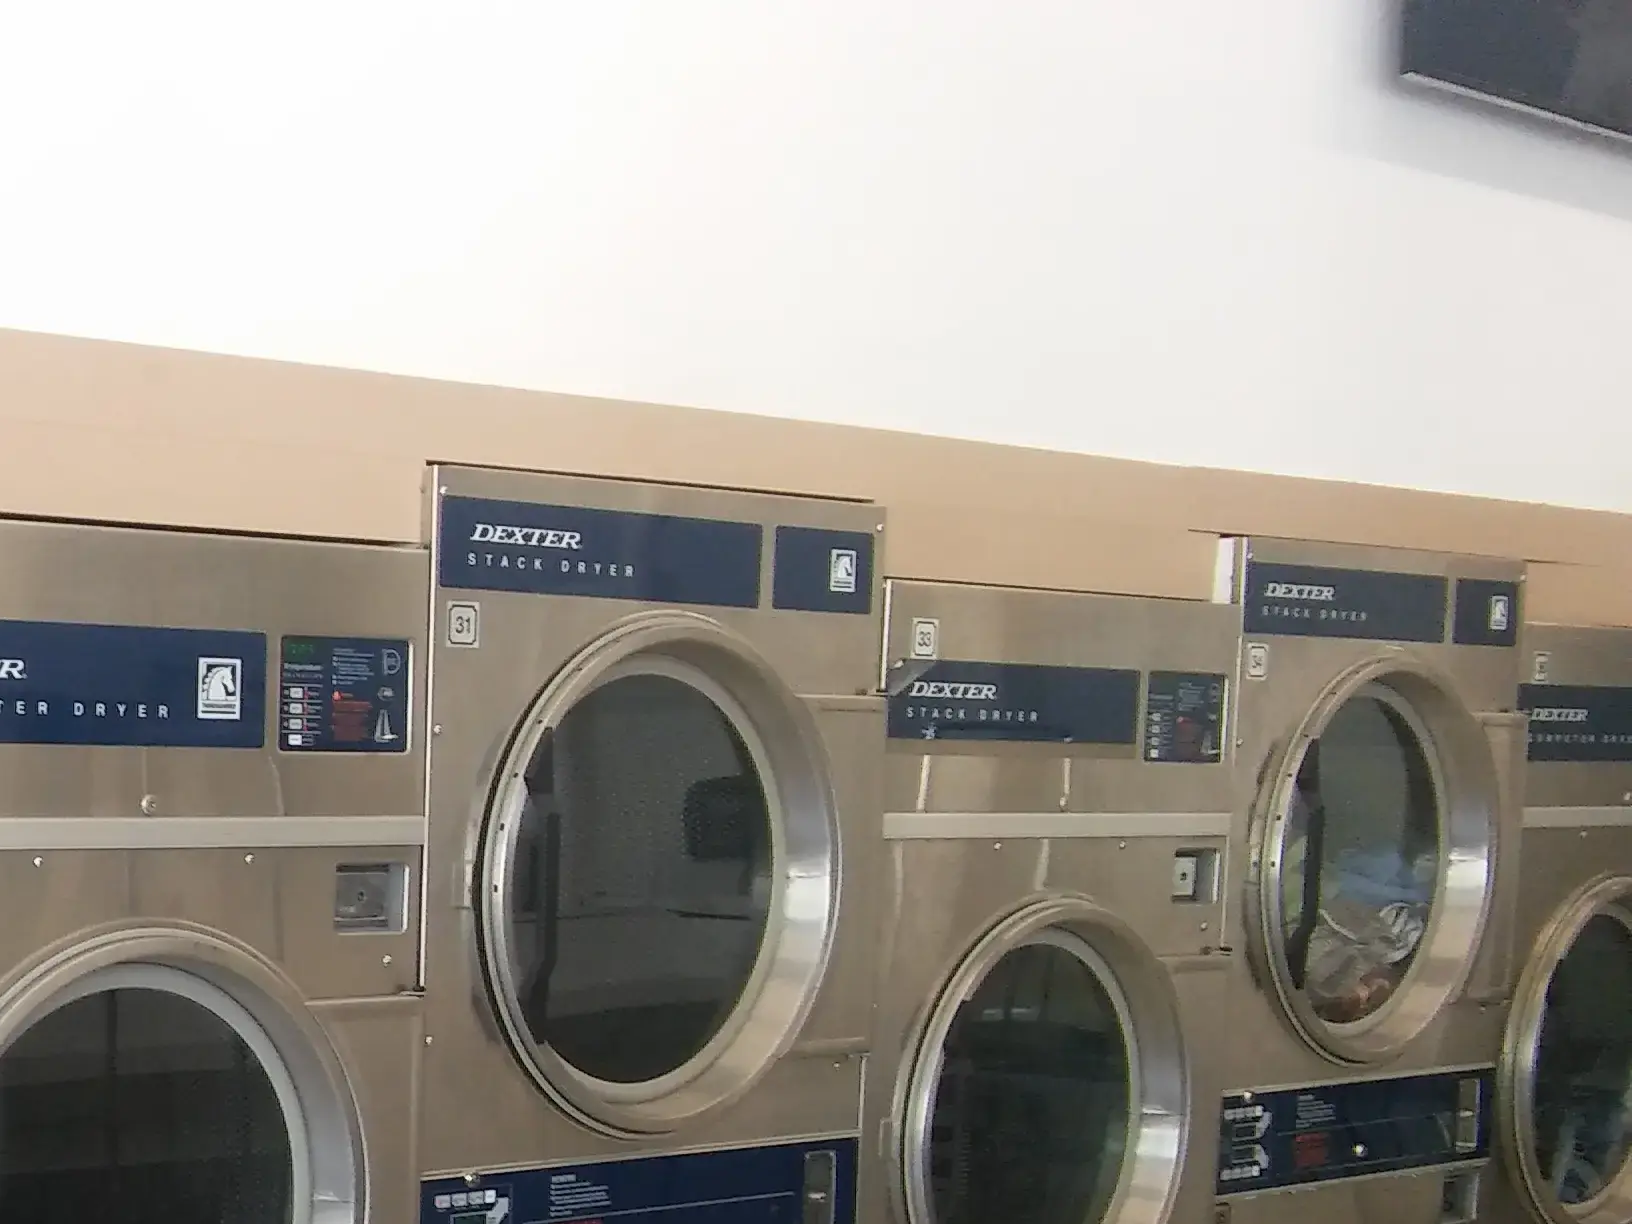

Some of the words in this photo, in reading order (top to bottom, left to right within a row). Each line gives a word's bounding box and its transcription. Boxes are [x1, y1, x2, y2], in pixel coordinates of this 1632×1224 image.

[470, 523, 583, 550] DEXTER
[468, 552, 543, 571] STACK
[561, 560, 636, 578] DRYER
[455, 615, 472, 635] 31
[909, 681, 998, 701] DEXTER
[72, 703, 170, 719] DRYER
[905, 705, 967, 720] STACK
